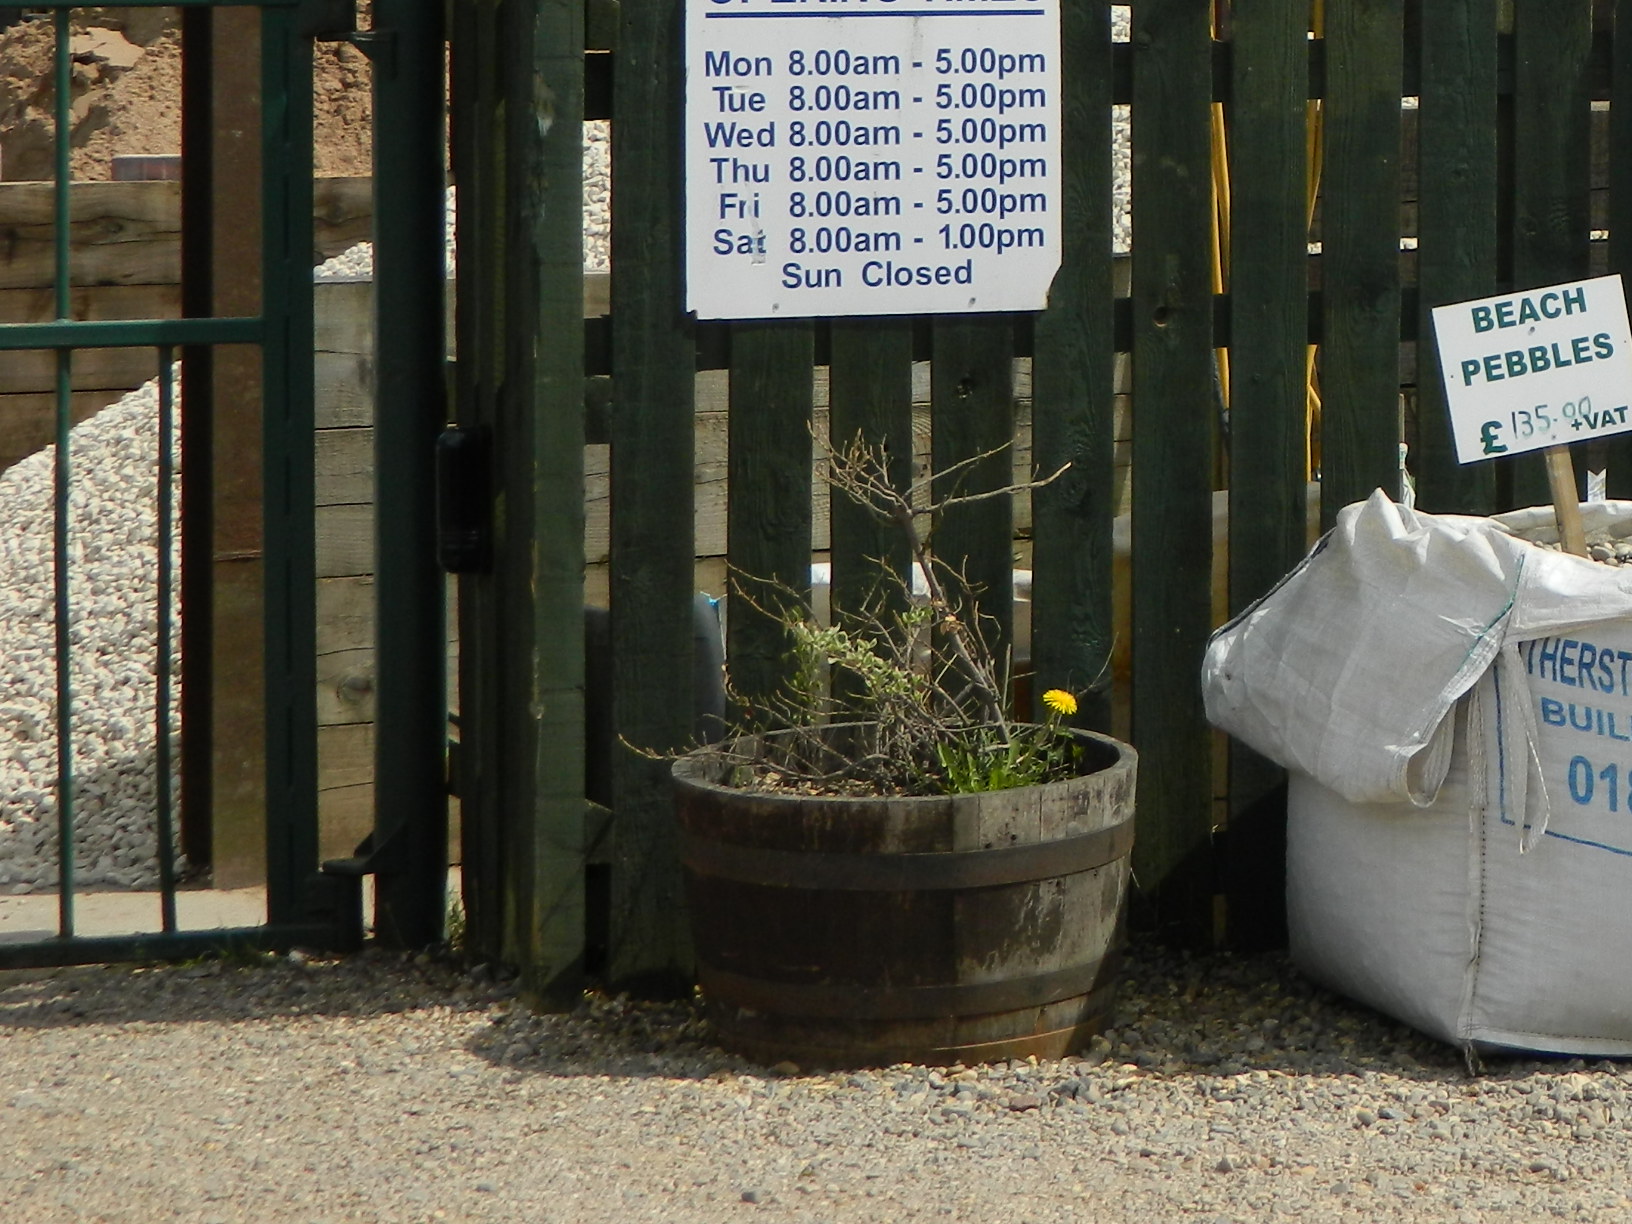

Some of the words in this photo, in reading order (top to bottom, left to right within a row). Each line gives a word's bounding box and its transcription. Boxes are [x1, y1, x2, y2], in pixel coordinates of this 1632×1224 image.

[705, 50, 772, 77] Mon
[788, 49, 900, 76] 8.00am
[935, 48, 1046, 79] 5.00pm
[712, 86, 766, 112] Tue
[788, 85, 900, 111] 8.00am
[935, 83, 1046, 114] 5.00pm
[704, 122, 775, 148] Wed
[788, 120, 900, 147] 8.00am
[936, 118, 1046, 149] 5.00pm
[710, 157, 770, 183] Thu
[789, 156, 900, 182] 8.00am
[936, 153, 1047, 184] 5.00pm
[719, 192, 760, 219] Fri
[789, 191, 900, 217] 8.00am
[936, 188, 1047, 219] 5.00pm
[713, 228, 767, 255] Sat
[789, 226, 900, 253] 8.00am
[938, 223, 1045, 254] 1.00pm
[781, 261, 842, 288] Sun
[861, 259, 973, 287] Closed
[1471, 287, 1587, 333] BEACH
[1461, 333, 1614, 386] PEBBLES
